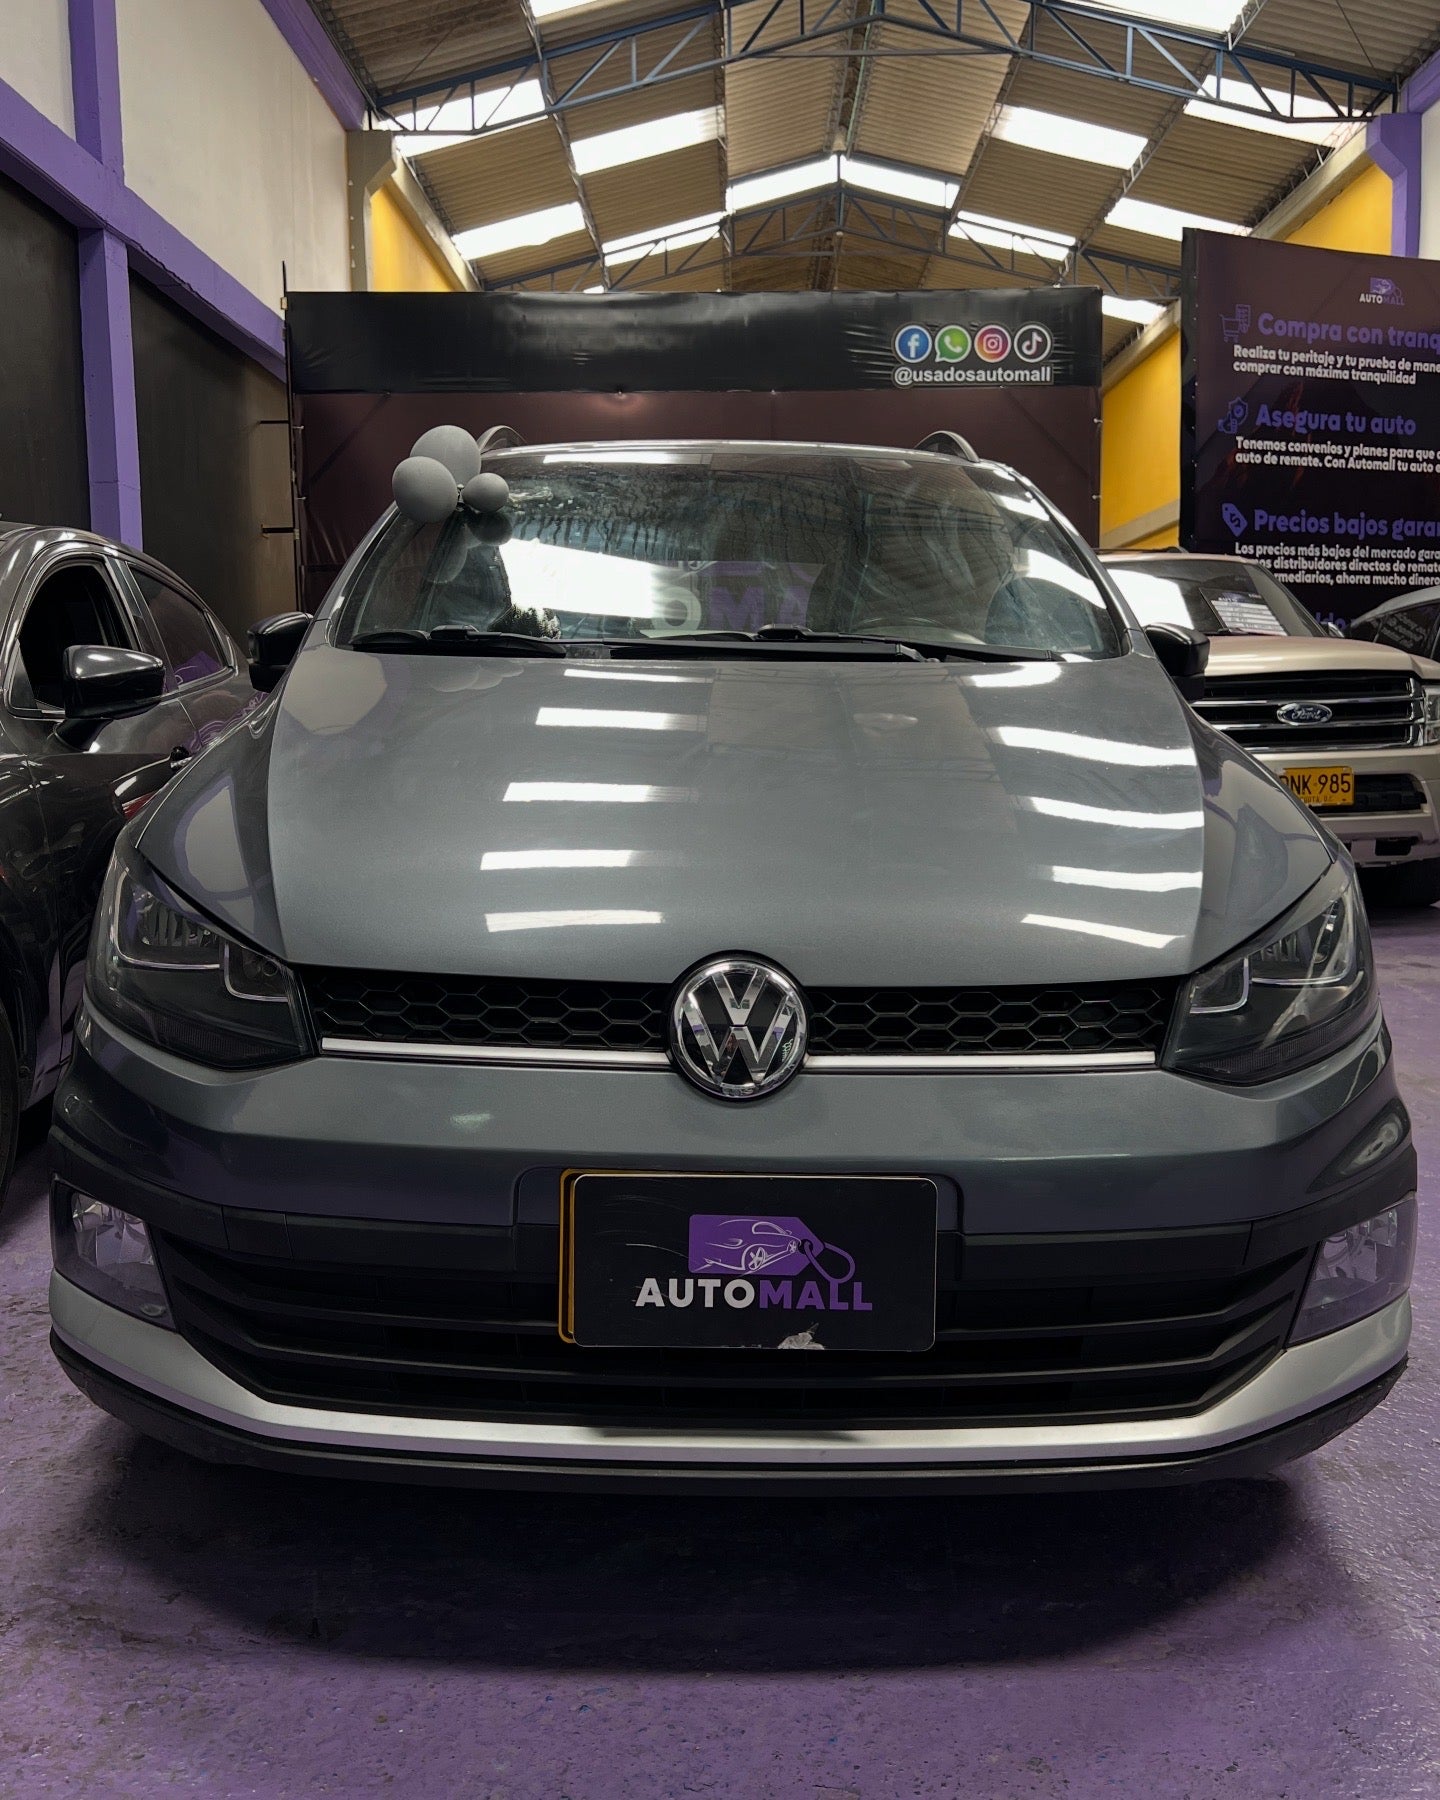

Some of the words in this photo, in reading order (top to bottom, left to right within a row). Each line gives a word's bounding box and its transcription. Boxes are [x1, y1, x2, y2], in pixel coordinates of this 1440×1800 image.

[1258, 312, 1342, 344] Compra
[1347, 326, 1383, 345] con
[1233, 344, 1276, 360] Realiza
[1278, 348, 1290, 361] tu
[1291, 349, 1335, 367] peritaje
[1336, 355, 1344, 368] y
[1345, 355, 1357, 366] tu
[1358, 356, 1396, 370] prueba
[1398, 358, 1412, 371] de
[894, 366, 1051, 386] @usadosautomall
[1233, 361, 1282, 376] comprar
[1283, 365, 1304, 376] con
[1305, 364, 1350, 380] máxima
[1351, 368, 1417, 385] tranquilidad
[1255, 404, 1341, 434] Asegura
[1345, 411, 1366, 433] tu
[1370, 415, 1416, 436] auto
[1236, 436, 1287, 452] Tenemos
[1288, 441, 1343, 455] convenios
[1344, 445, 1352, 458] y
[1353, 443, 1388, 458] planes
[1389, 448, 1415, 461] para
[1415, 450, 1436, 462] que
[1235, 452, 1262, 464] auto
[1263, 451, 1279, 465] de
[1280, 455, 1323, 467] remate.
[1324, 455, 1346, 468] Con
[1347, 457, 1396, 471] Automall
[1397, 460, 1409, 471] tu
[1410, 461, 1434, 473] auto
[1254, 509, 1330, 534] Precios
[1334, 512, 1388, 541] bajos
[1235, 542, 1254, 555] Los
[1256, 542, 1296, 558] precios
[1297, 544, 1321, 557] más
[1322, 544, 1351, 560] bajos
[1352, 545, 1369, 558] del
[1370, 546, 1417, 559] mercado
[1273, 556, 1347, 571] distribuidores
[1348, 558, 1391, 572] directos
[1392, 560, 1406, 572] de
[1335, 572, 1371, 585] ahorra
[1372, 573, 1407, 586] mucho
[1291, 708, 1321, 720] Ford
[1317, 773, 1351, 794] 985
[635, 1277, 873, 1311] AUTOMALL
